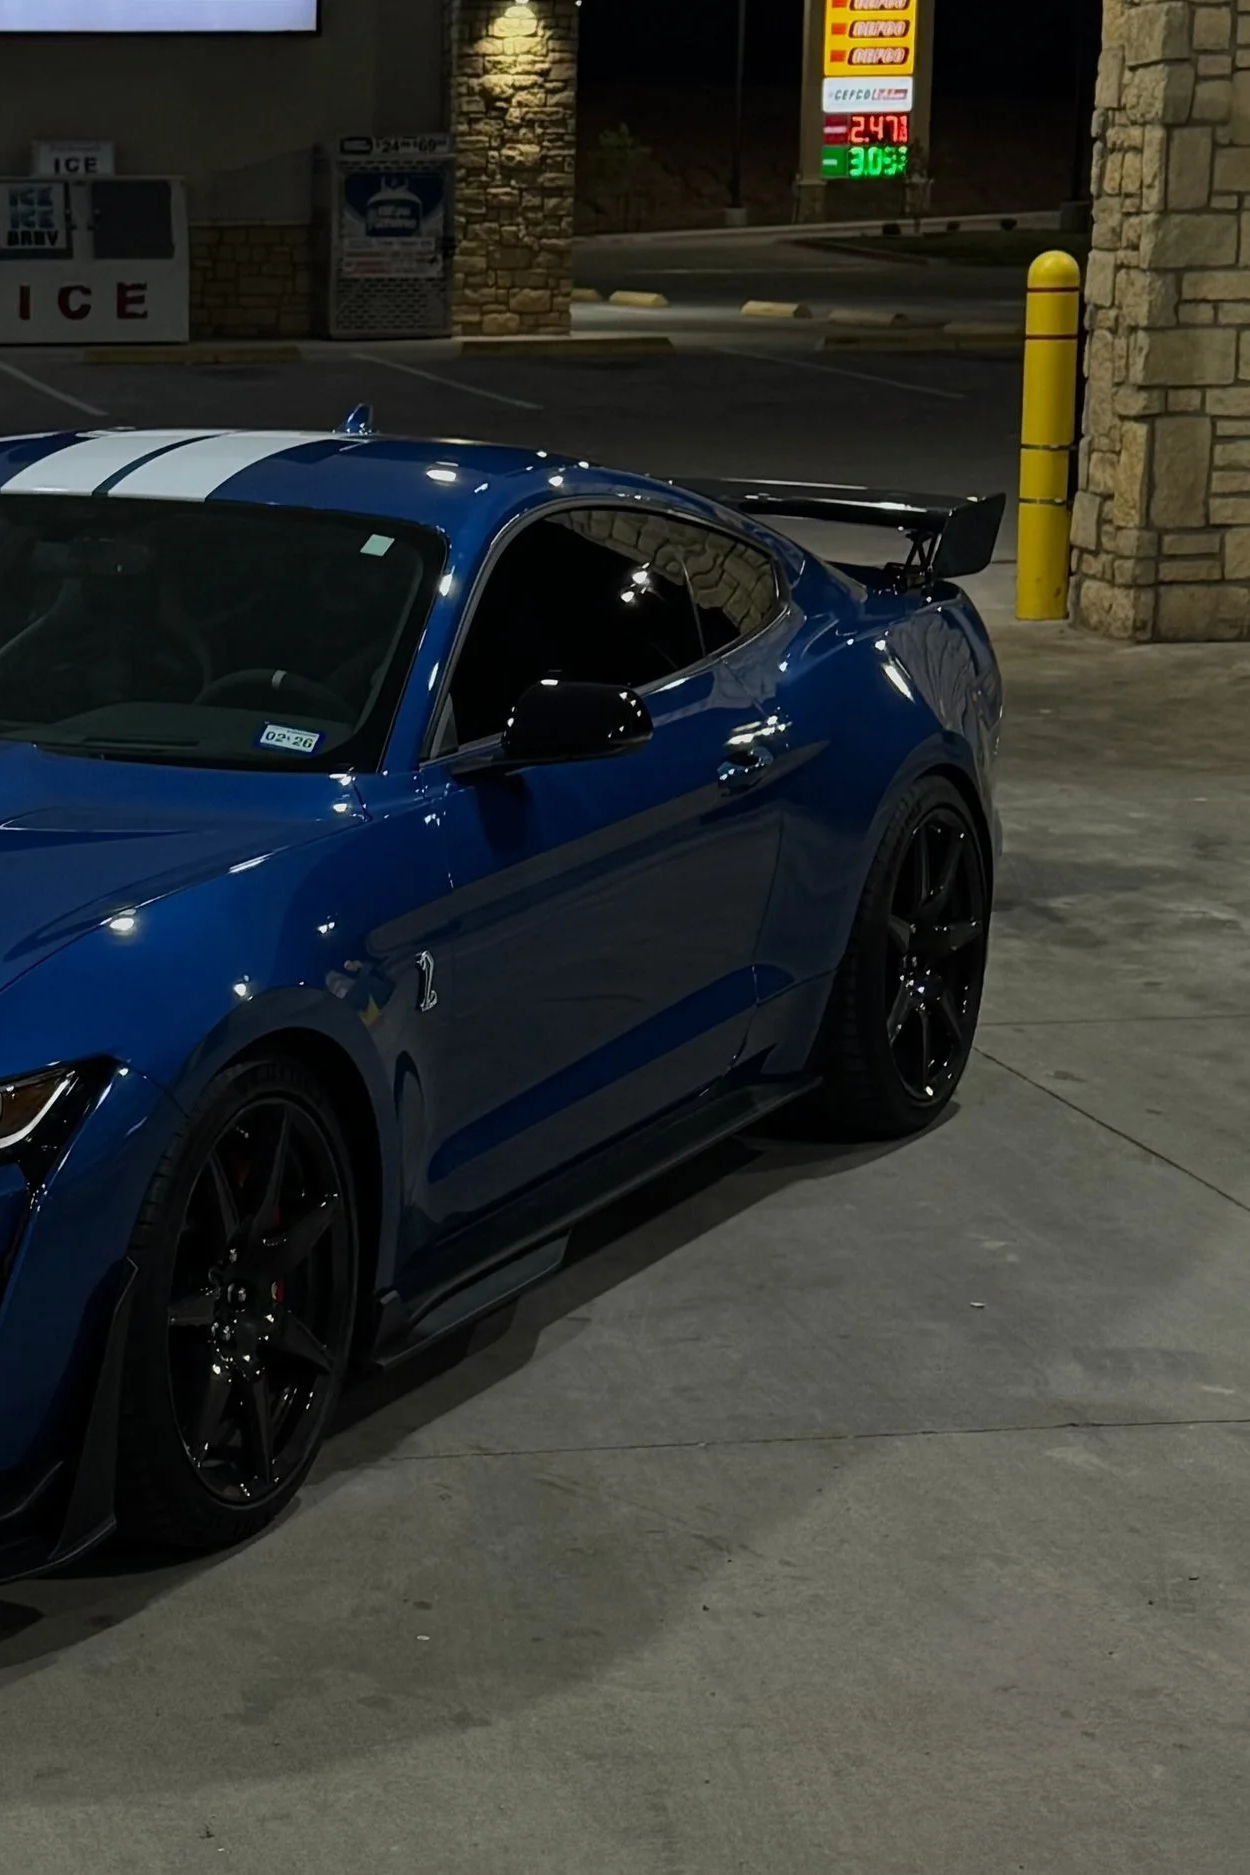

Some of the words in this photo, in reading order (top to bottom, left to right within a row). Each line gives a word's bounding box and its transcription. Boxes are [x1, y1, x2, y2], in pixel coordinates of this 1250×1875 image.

[834, 88, 871, 101] CEFCO
[53, 156, 100, 173] ICE
[19, 281, 149, 320] ICE
